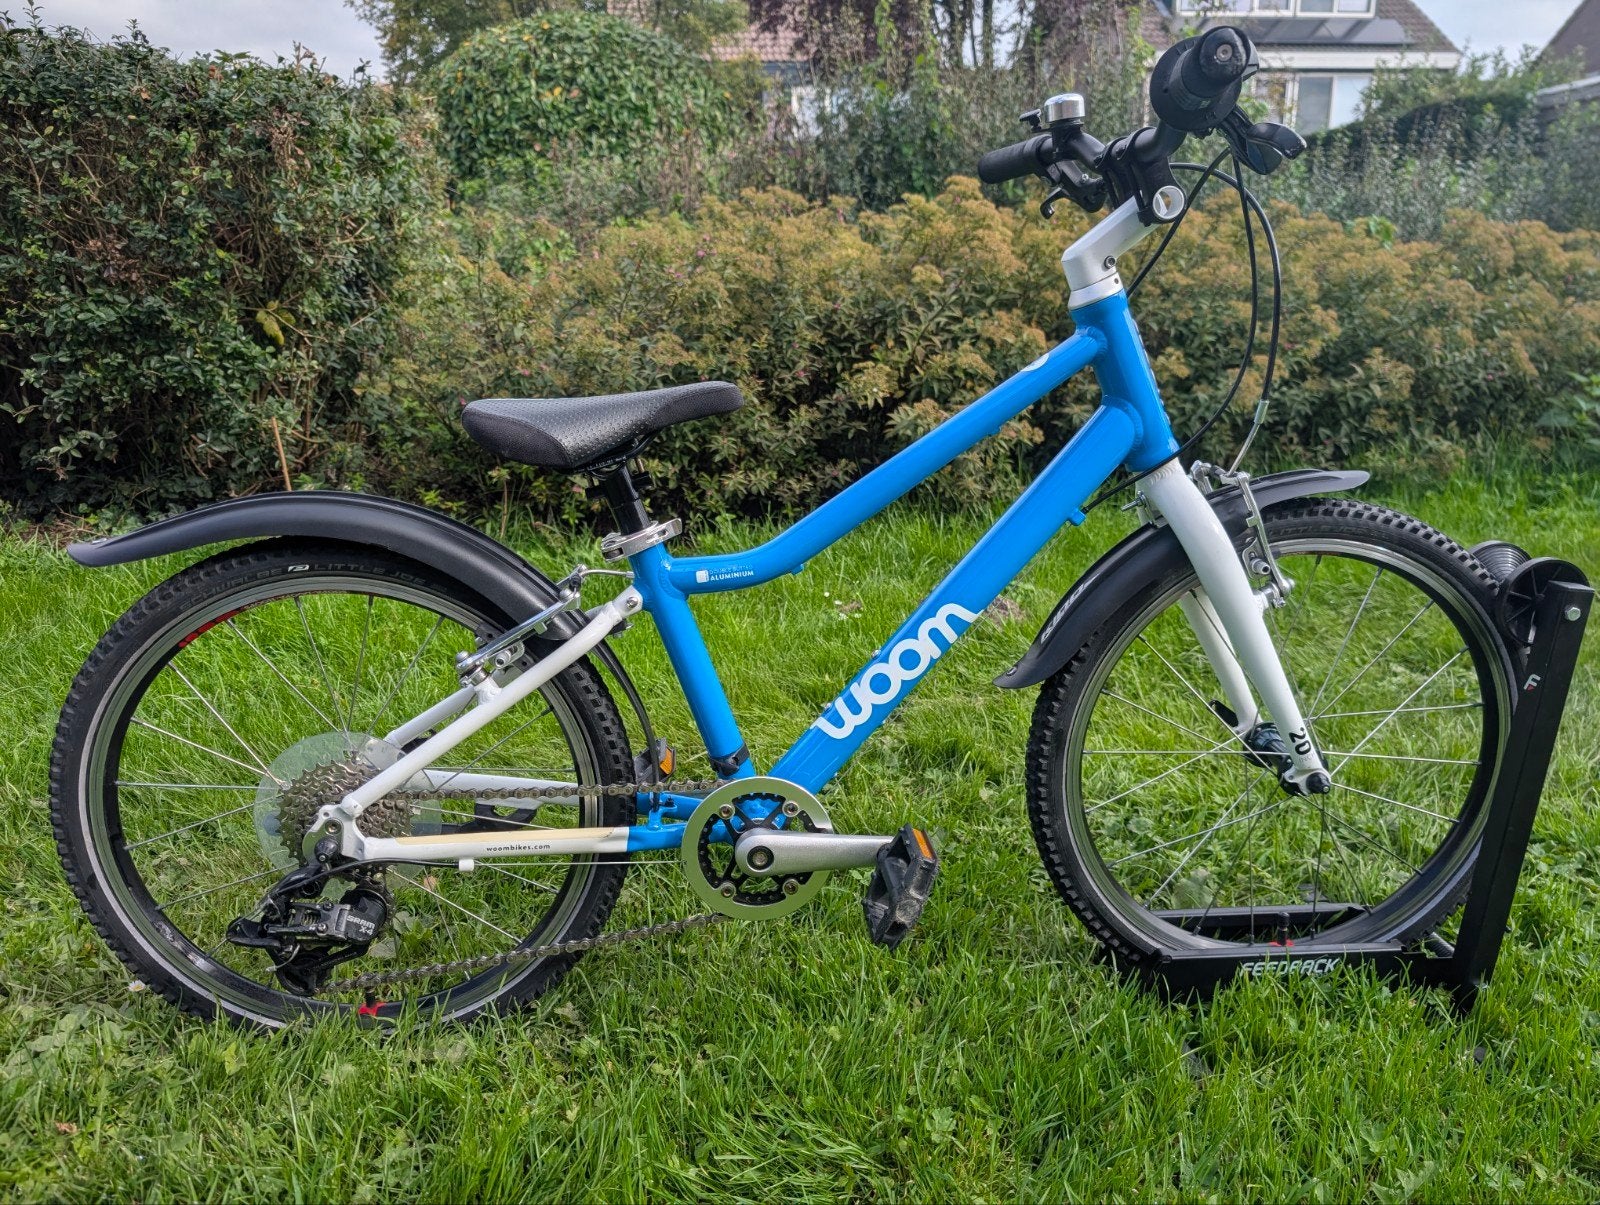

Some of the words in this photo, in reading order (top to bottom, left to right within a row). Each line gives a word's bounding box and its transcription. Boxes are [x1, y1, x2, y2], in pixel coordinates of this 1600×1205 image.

[313, 563, 386, 575] LITTLE
[388, 570, 427, 586] JOE
[709, 569, 755, 582] ALUMINIUM
[810, 603, 984, 740] woom
[1288, 726, 1312, 756] 20
[486, 843, 551, 852] woombikes.com
[346, 914, 376, 930] SRAM
